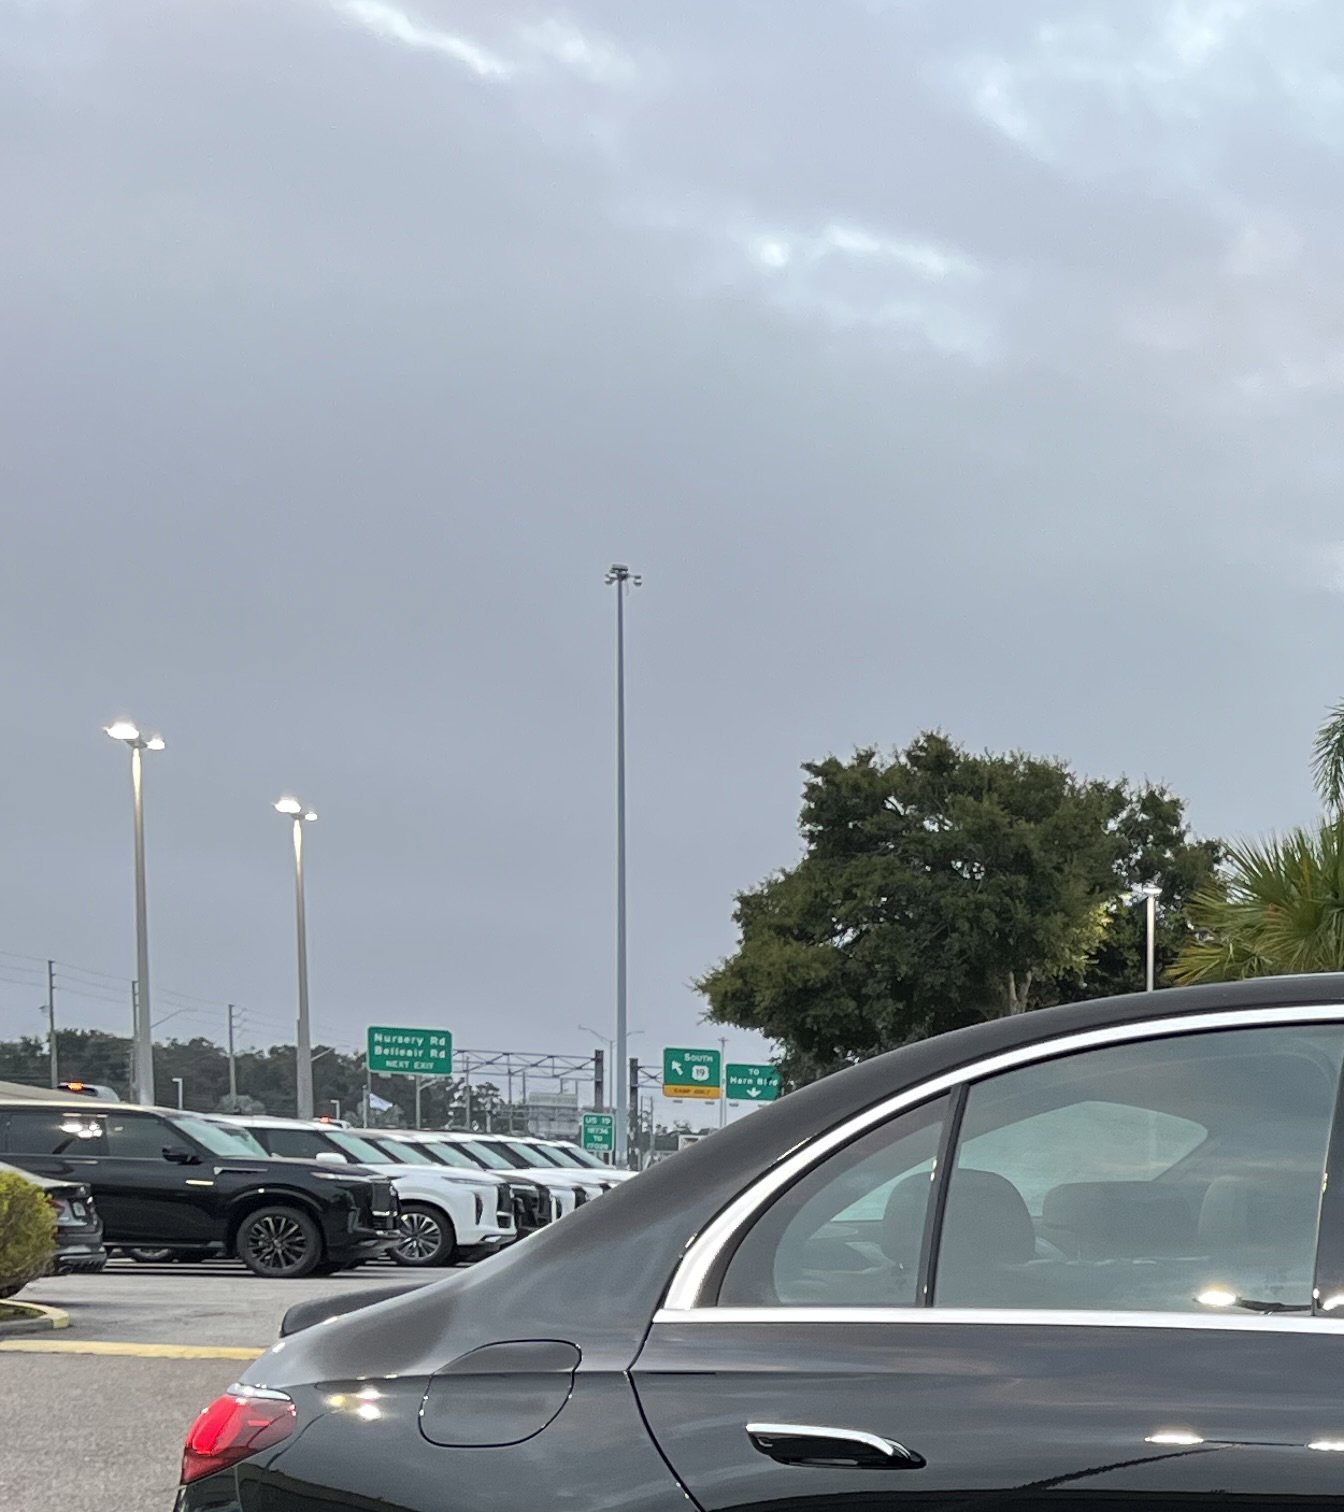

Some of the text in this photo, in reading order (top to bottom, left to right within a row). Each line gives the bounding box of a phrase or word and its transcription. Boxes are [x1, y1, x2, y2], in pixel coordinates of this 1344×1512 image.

[374, 1033, 446, 1046] Nursery Rd
[374, 1045, 446, 1059] Belleair Rd
[385, 1060, 434, 1070] NEXT EXIT
[695, 1068, 705, 1078] 19
[748, 1068, 760, 1076] TO
[601, 1117, 610, 1125] 19
